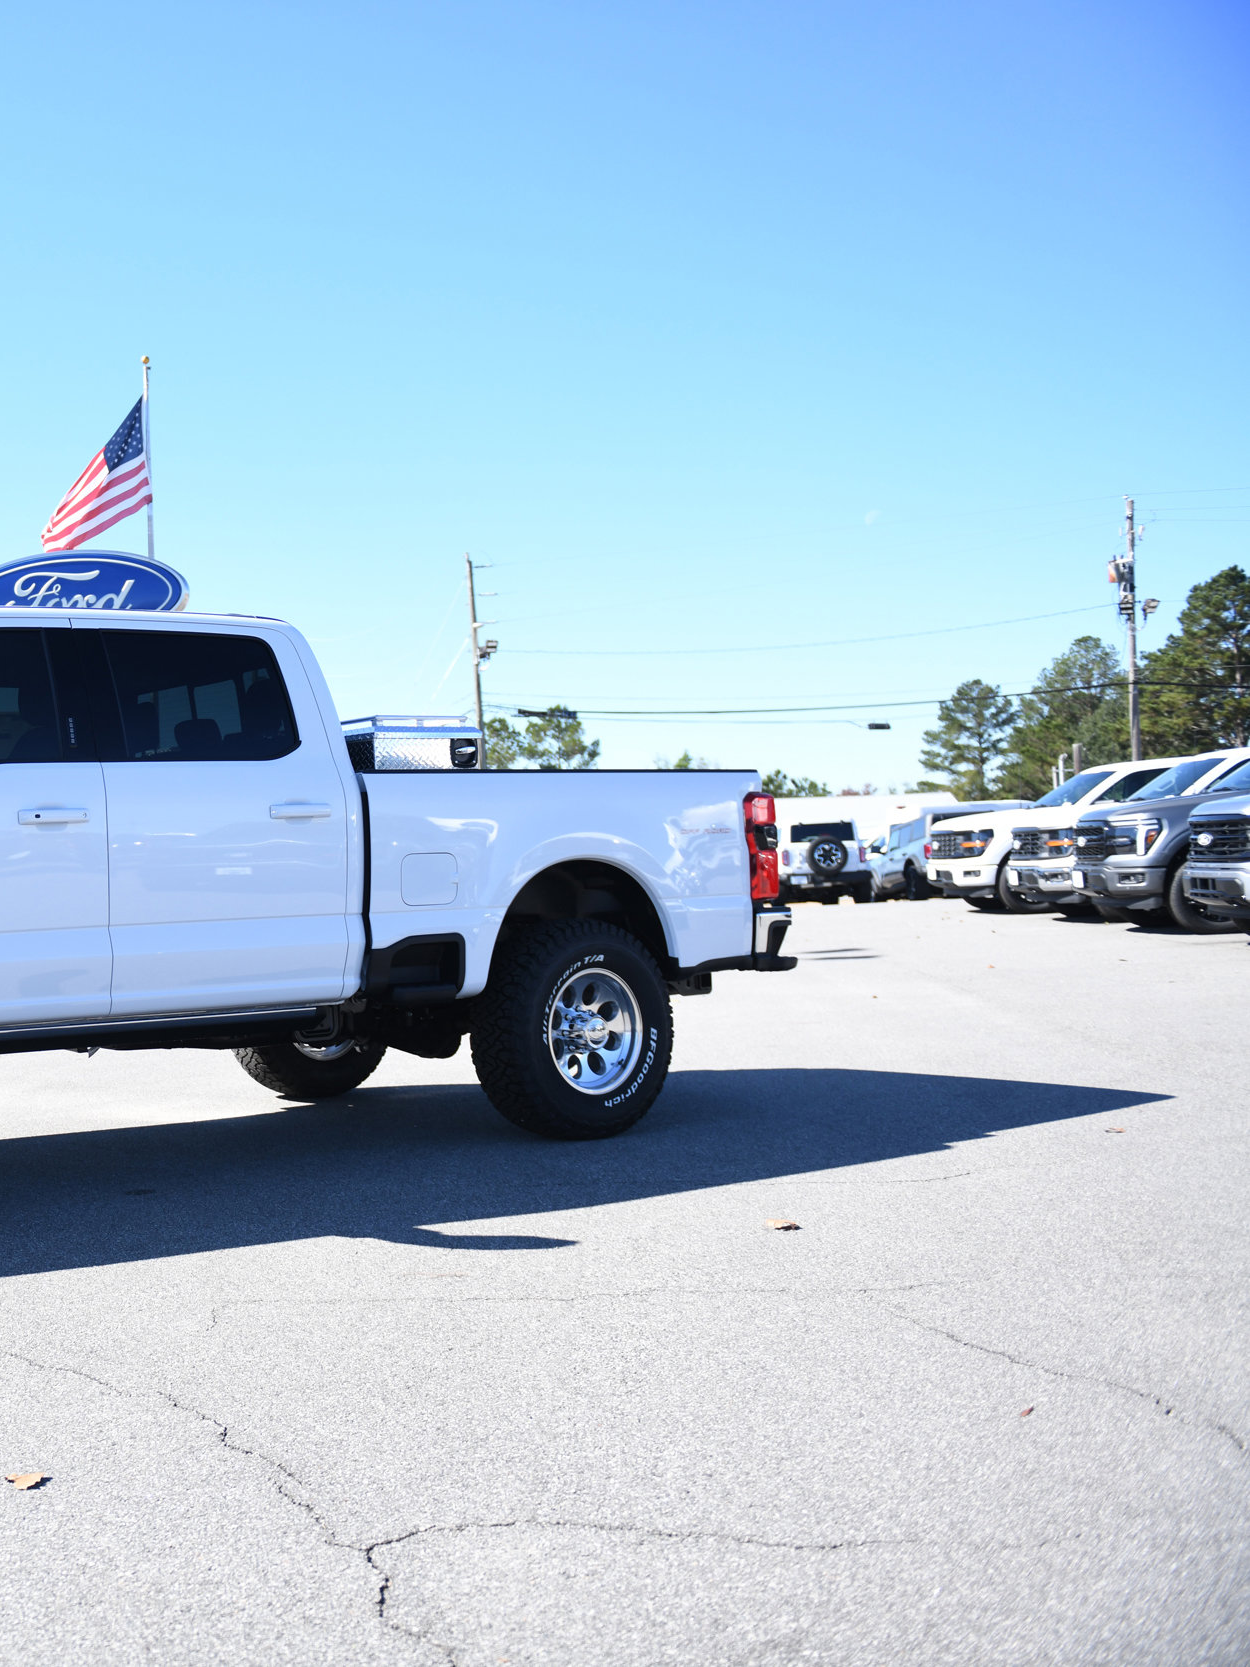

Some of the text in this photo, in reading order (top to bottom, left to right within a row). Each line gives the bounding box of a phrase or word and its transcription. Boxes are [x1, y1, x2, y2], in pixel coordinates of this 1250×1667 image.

[5, 570, 134, 609] Ford
[583, 954, 605, 965] T/A
[604, 1026, 658, 1108] BFGoodrich
